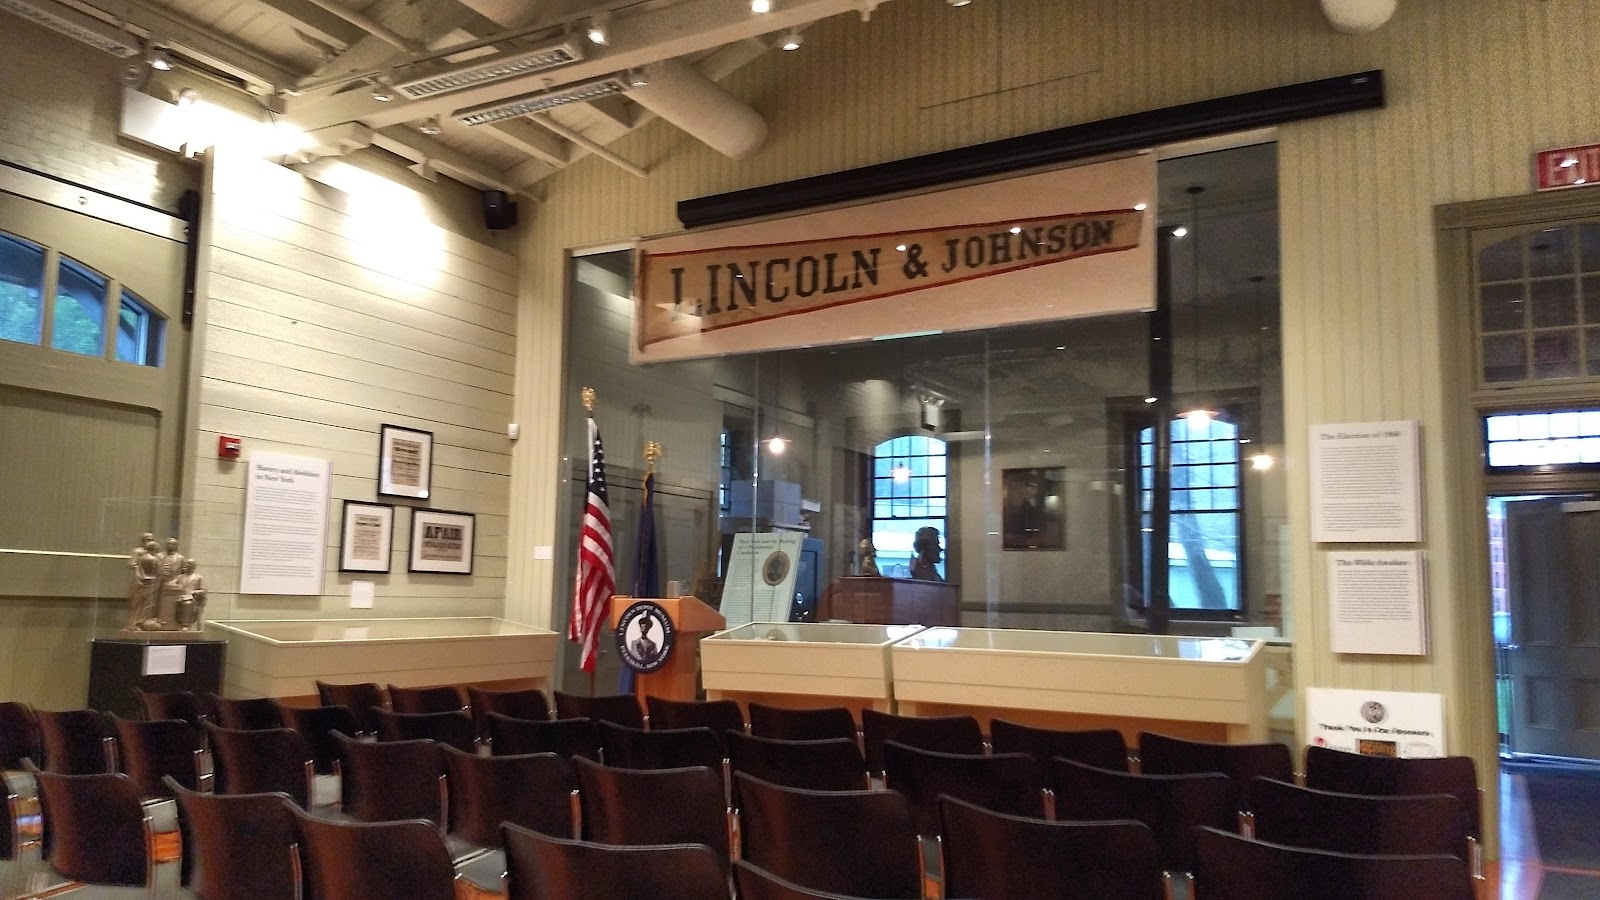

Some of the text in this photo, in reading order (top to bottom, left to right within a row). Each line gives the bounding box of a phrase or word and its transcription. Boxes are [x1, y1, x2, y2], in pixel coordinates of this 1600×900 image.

[671, 219, 1116, 322] LINCOLN & JOHNSON
